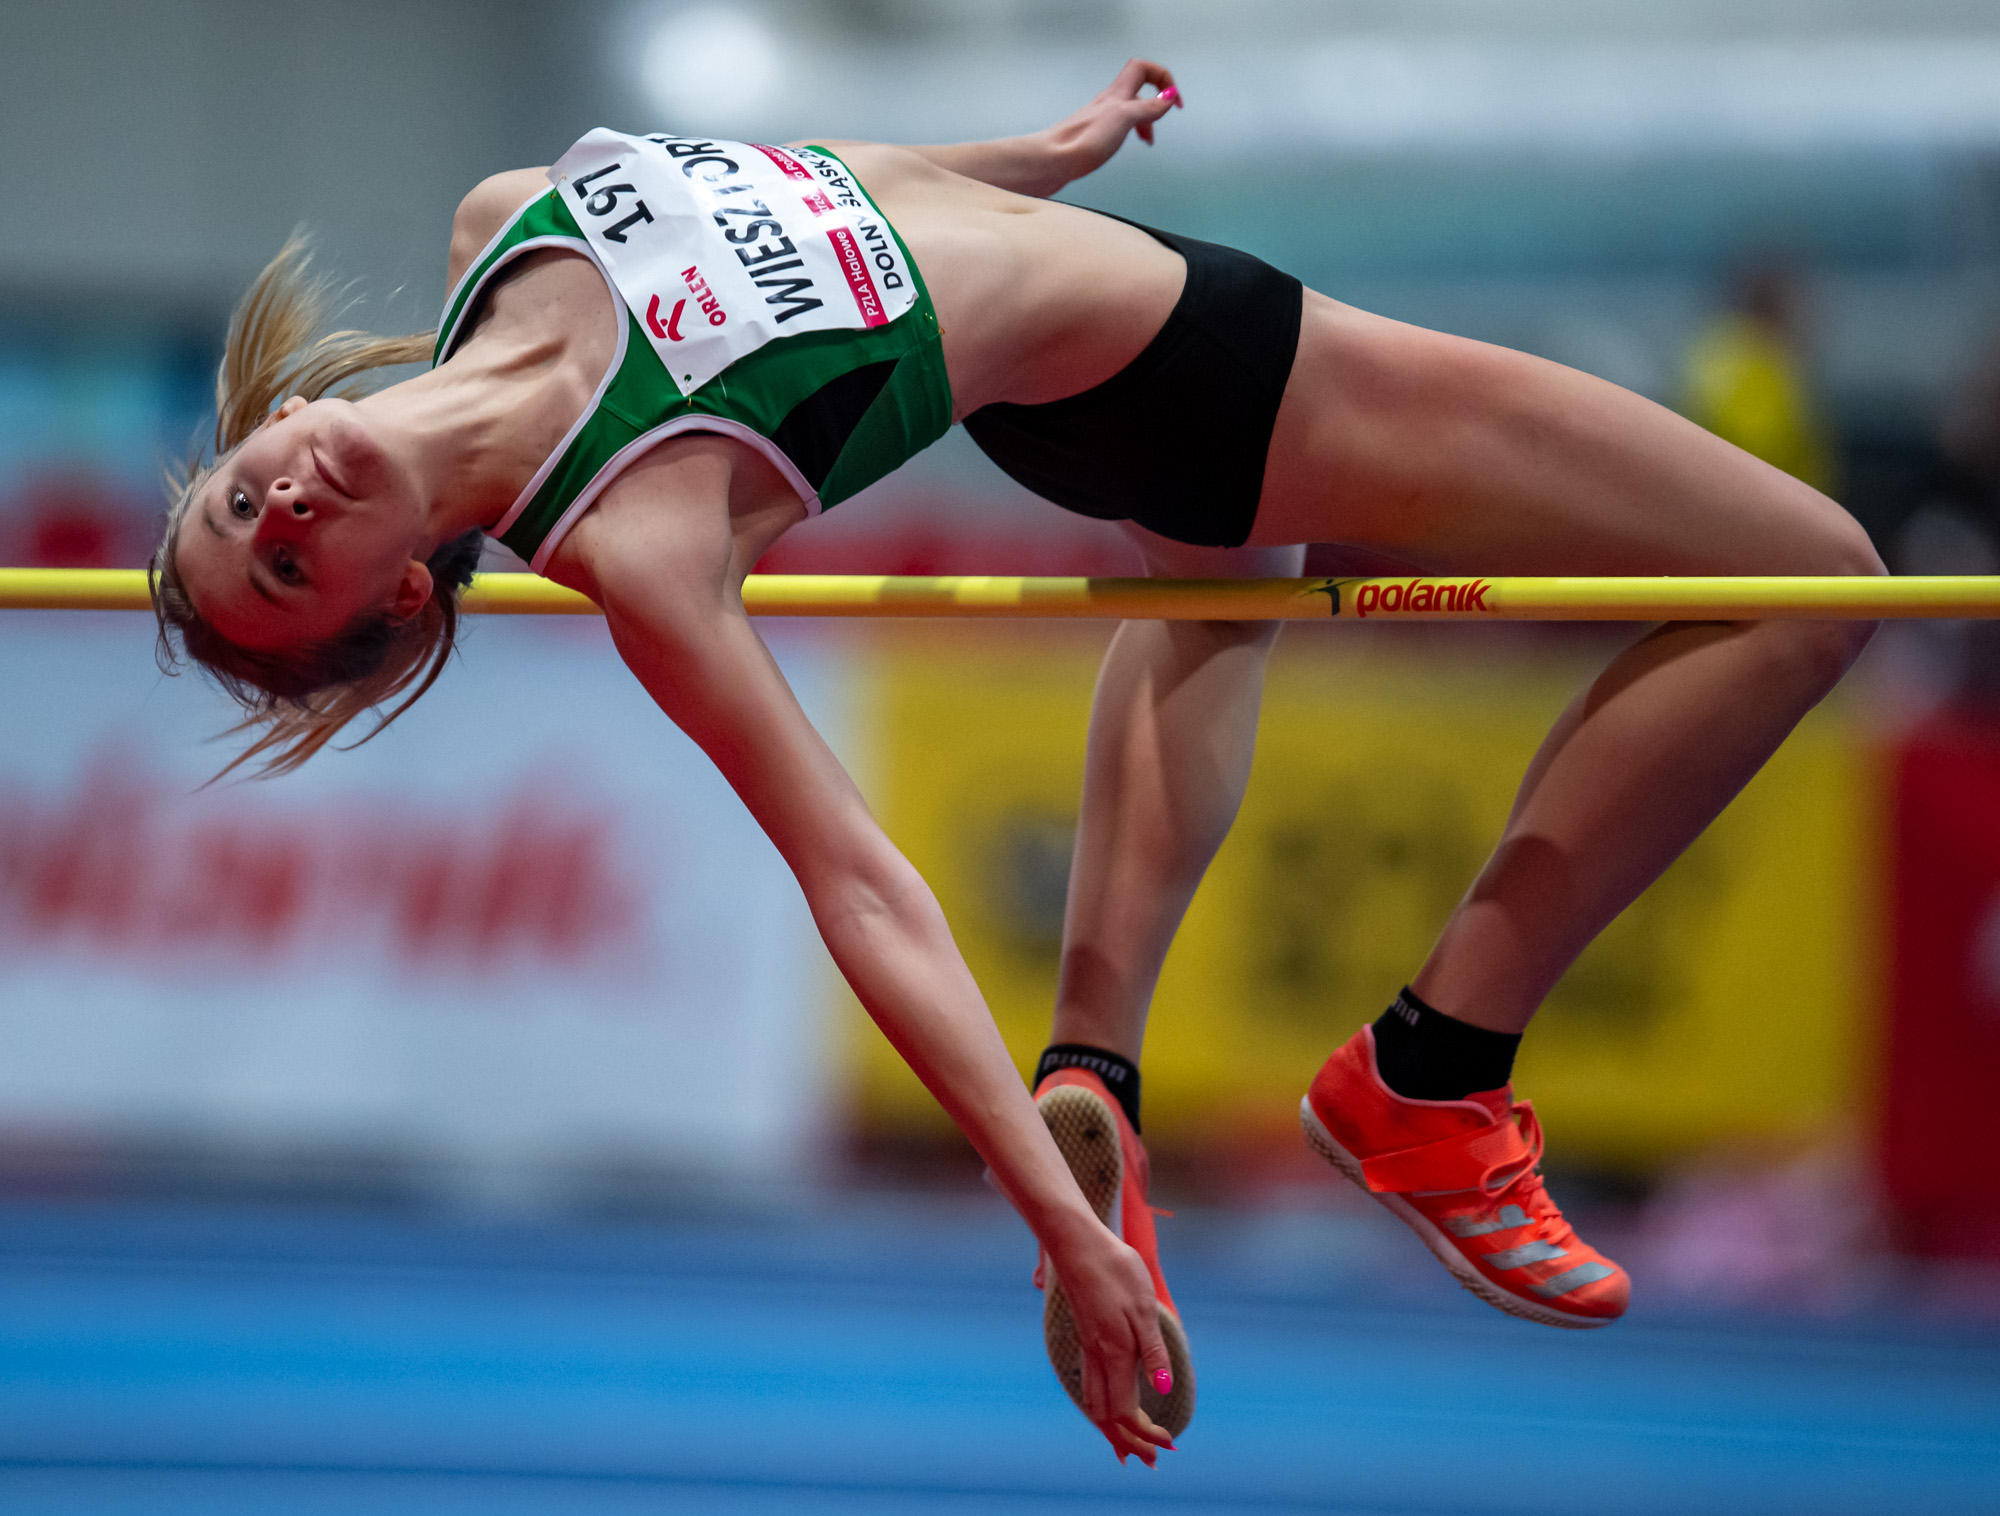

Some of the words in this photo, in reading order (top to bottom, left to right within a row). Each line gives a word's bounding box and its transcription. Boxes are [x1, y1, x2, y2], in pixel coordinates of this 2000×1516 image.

[571, 162, 655, 245] 197
[808, 159, 862, 208] ŚLĄSK
[836, 230, 865, 282] Halowe
[680, 264, 727, 327] ORLEN
[857, 283, 880, 317] PZLA
[1356, 578, 1493, 618] polanik
